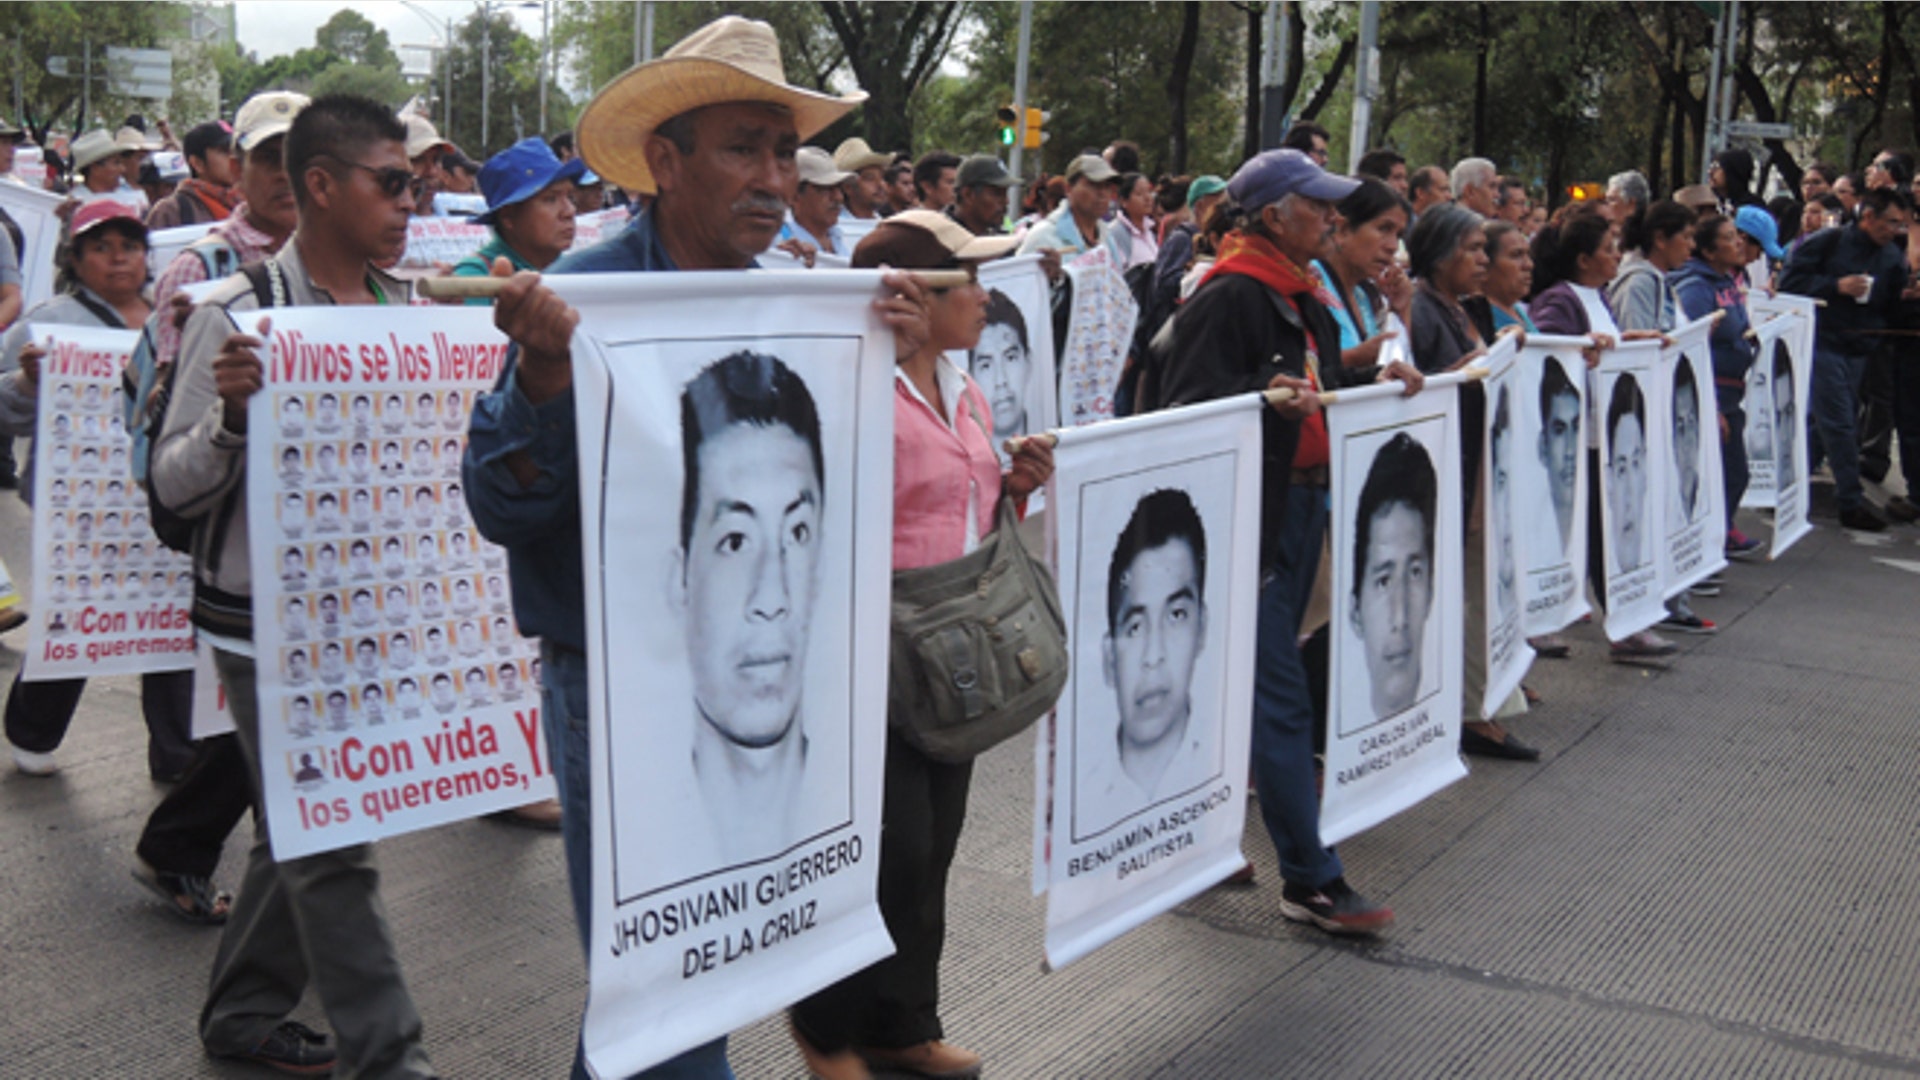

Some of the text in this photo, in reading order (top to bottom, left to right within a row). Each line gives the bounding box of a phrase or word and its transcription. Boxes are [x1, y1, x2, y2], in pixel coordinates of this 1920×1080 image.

[270, 329, 353, 383] ¡Vivos
[359, 343, 390, 382] se
[388, 331, 432, 382] los
[135, 603, 191, 632] vida
[43, 639, 78, 662] los
[331, 736, 414, 783] ¡Con
[422, 716, 500, 766] vida
[297, 761, 529, 831] los queremos,
[1157, 784, 1232, 837] ASCENCIO
[1117, 830, 1194, 880] BAUTISTA
[611, 834, 863, 957] JHOSIVANI GUERRERO
[683, 900, 818, 979] DE LA CRUZ
